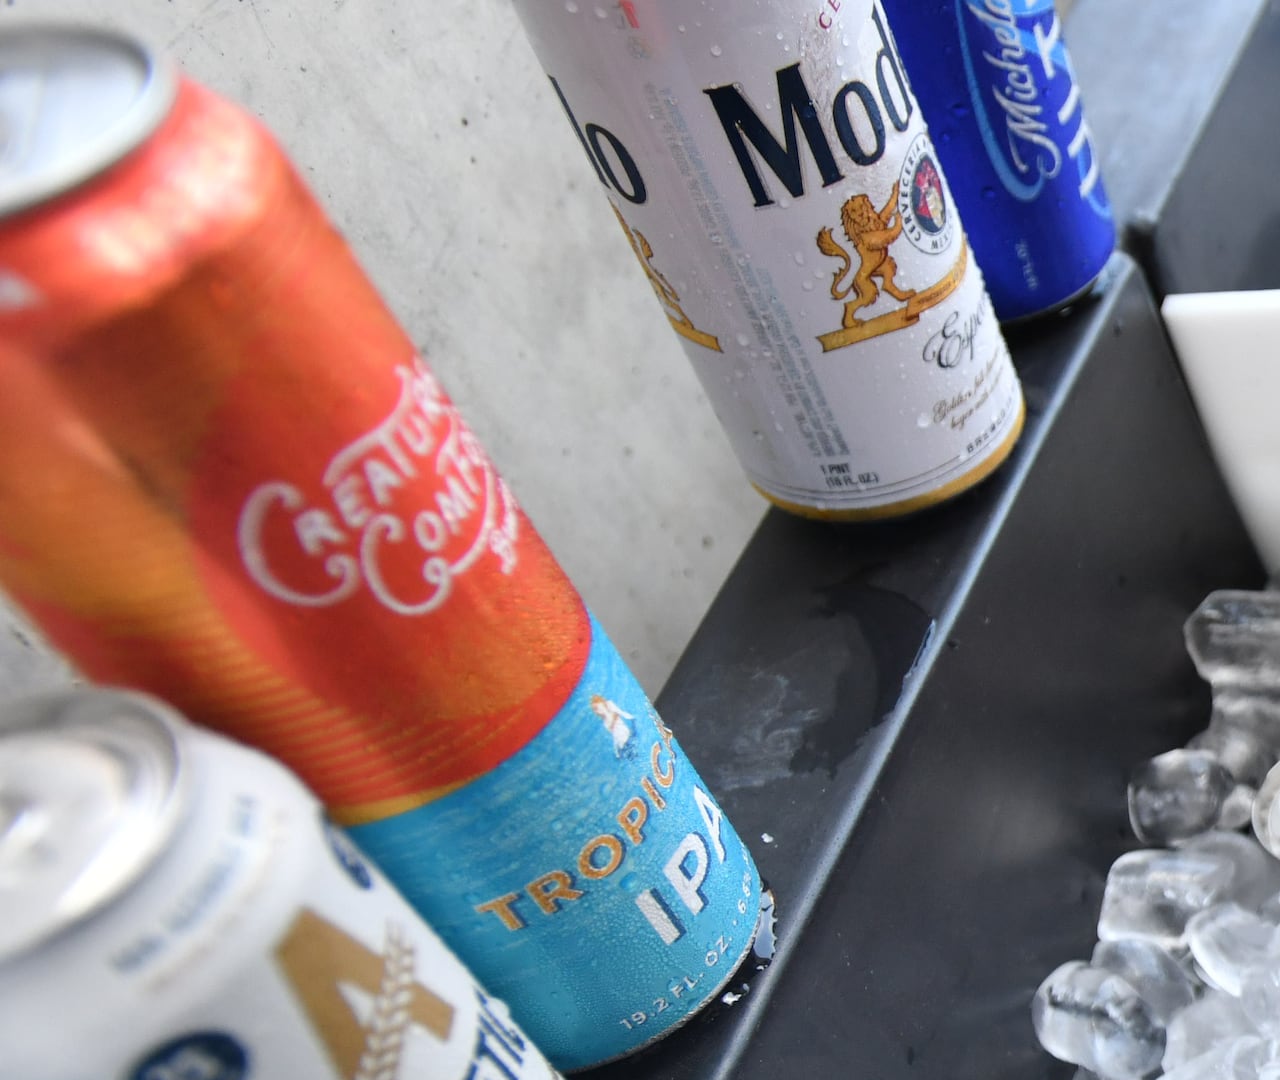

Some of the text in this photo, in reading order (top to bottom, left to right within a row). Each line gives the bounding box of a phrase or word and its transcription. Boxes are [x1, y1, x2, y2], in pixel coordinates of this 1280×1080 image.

[635, 783, 728, 947] IPA
[619, 996, 670, 1031] 19.2
[670, 971, 704, 999] FL.
[704, 934, 733, 967] OZ.
